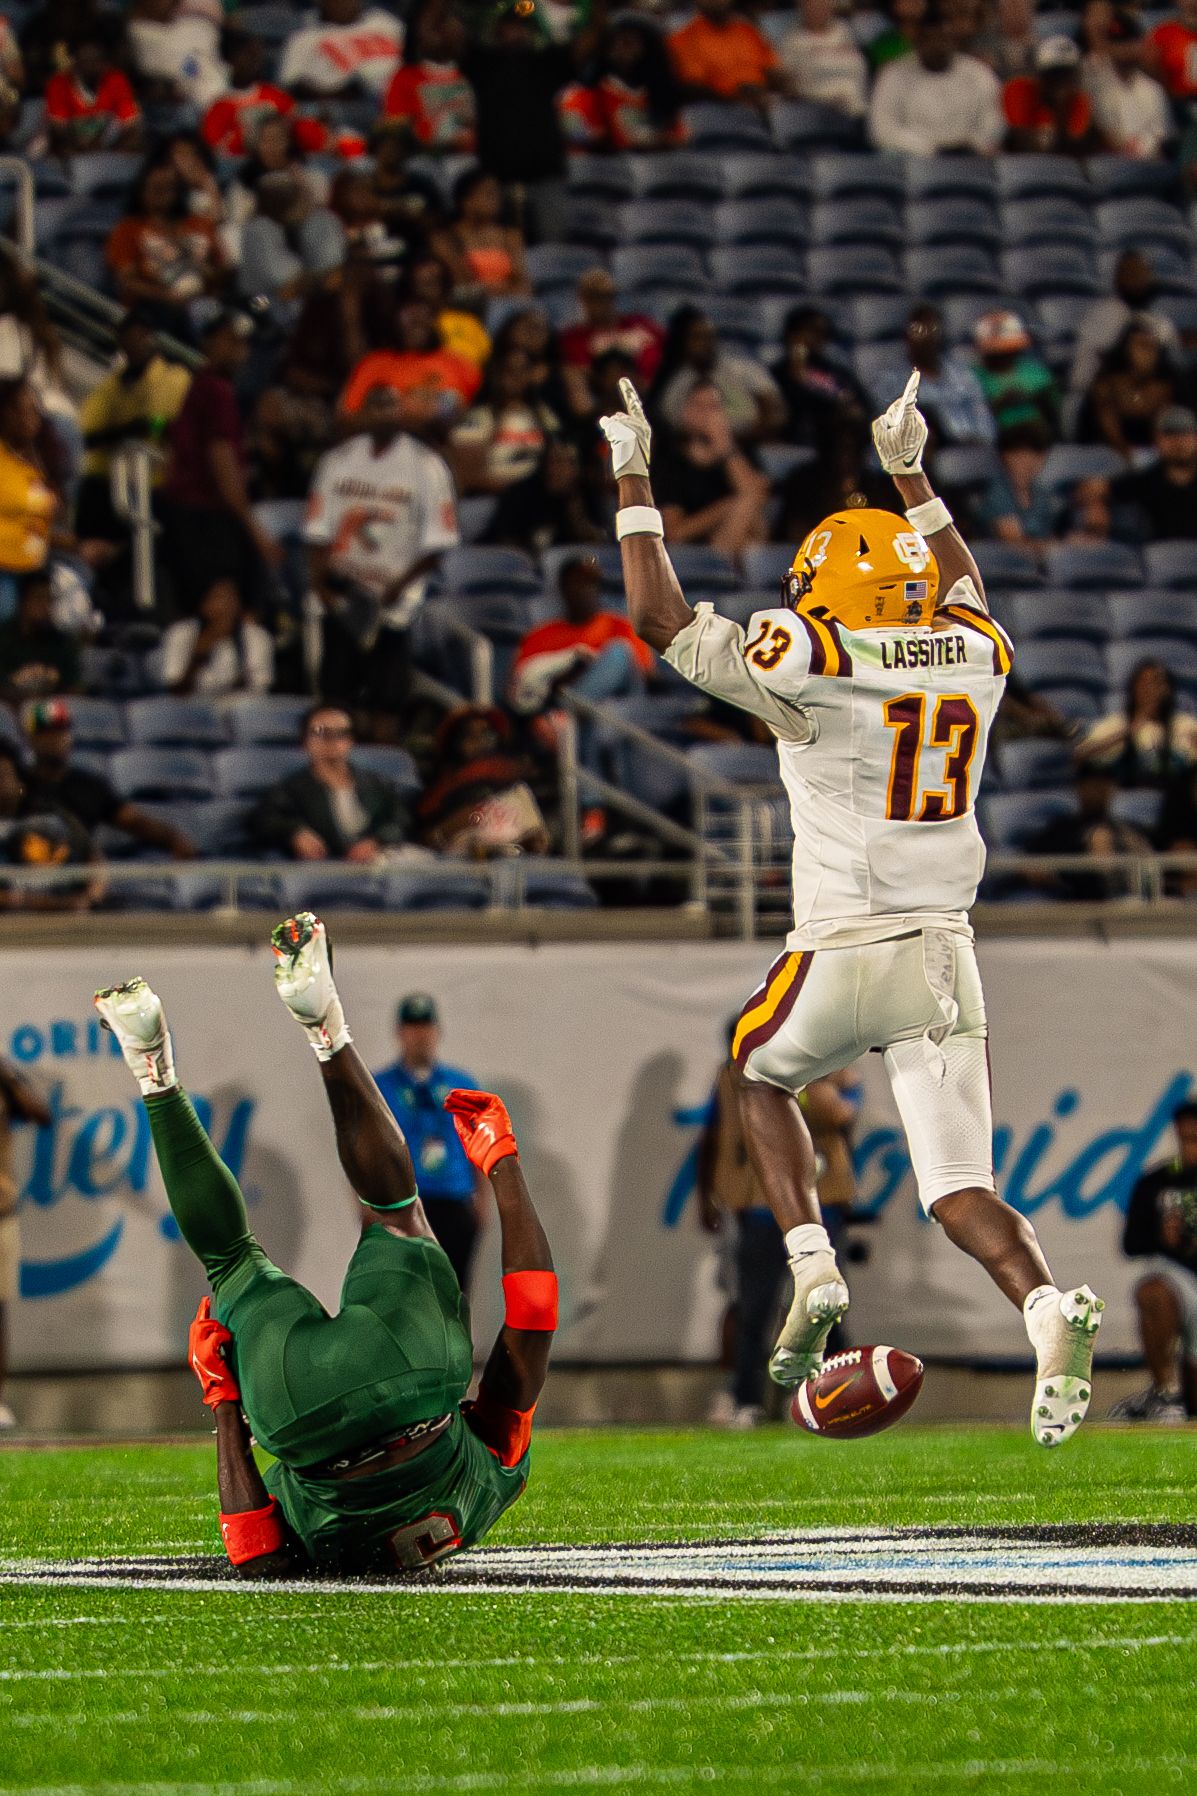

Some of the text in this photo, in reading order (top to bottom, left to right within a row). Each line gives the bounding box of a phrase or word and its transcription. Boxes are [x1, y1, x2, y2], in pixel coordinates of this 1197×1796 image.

[744, 619, 793, 672] 13
[880, 635, 968, 669] LASSITER
[882, 692, 980, 821] 13
